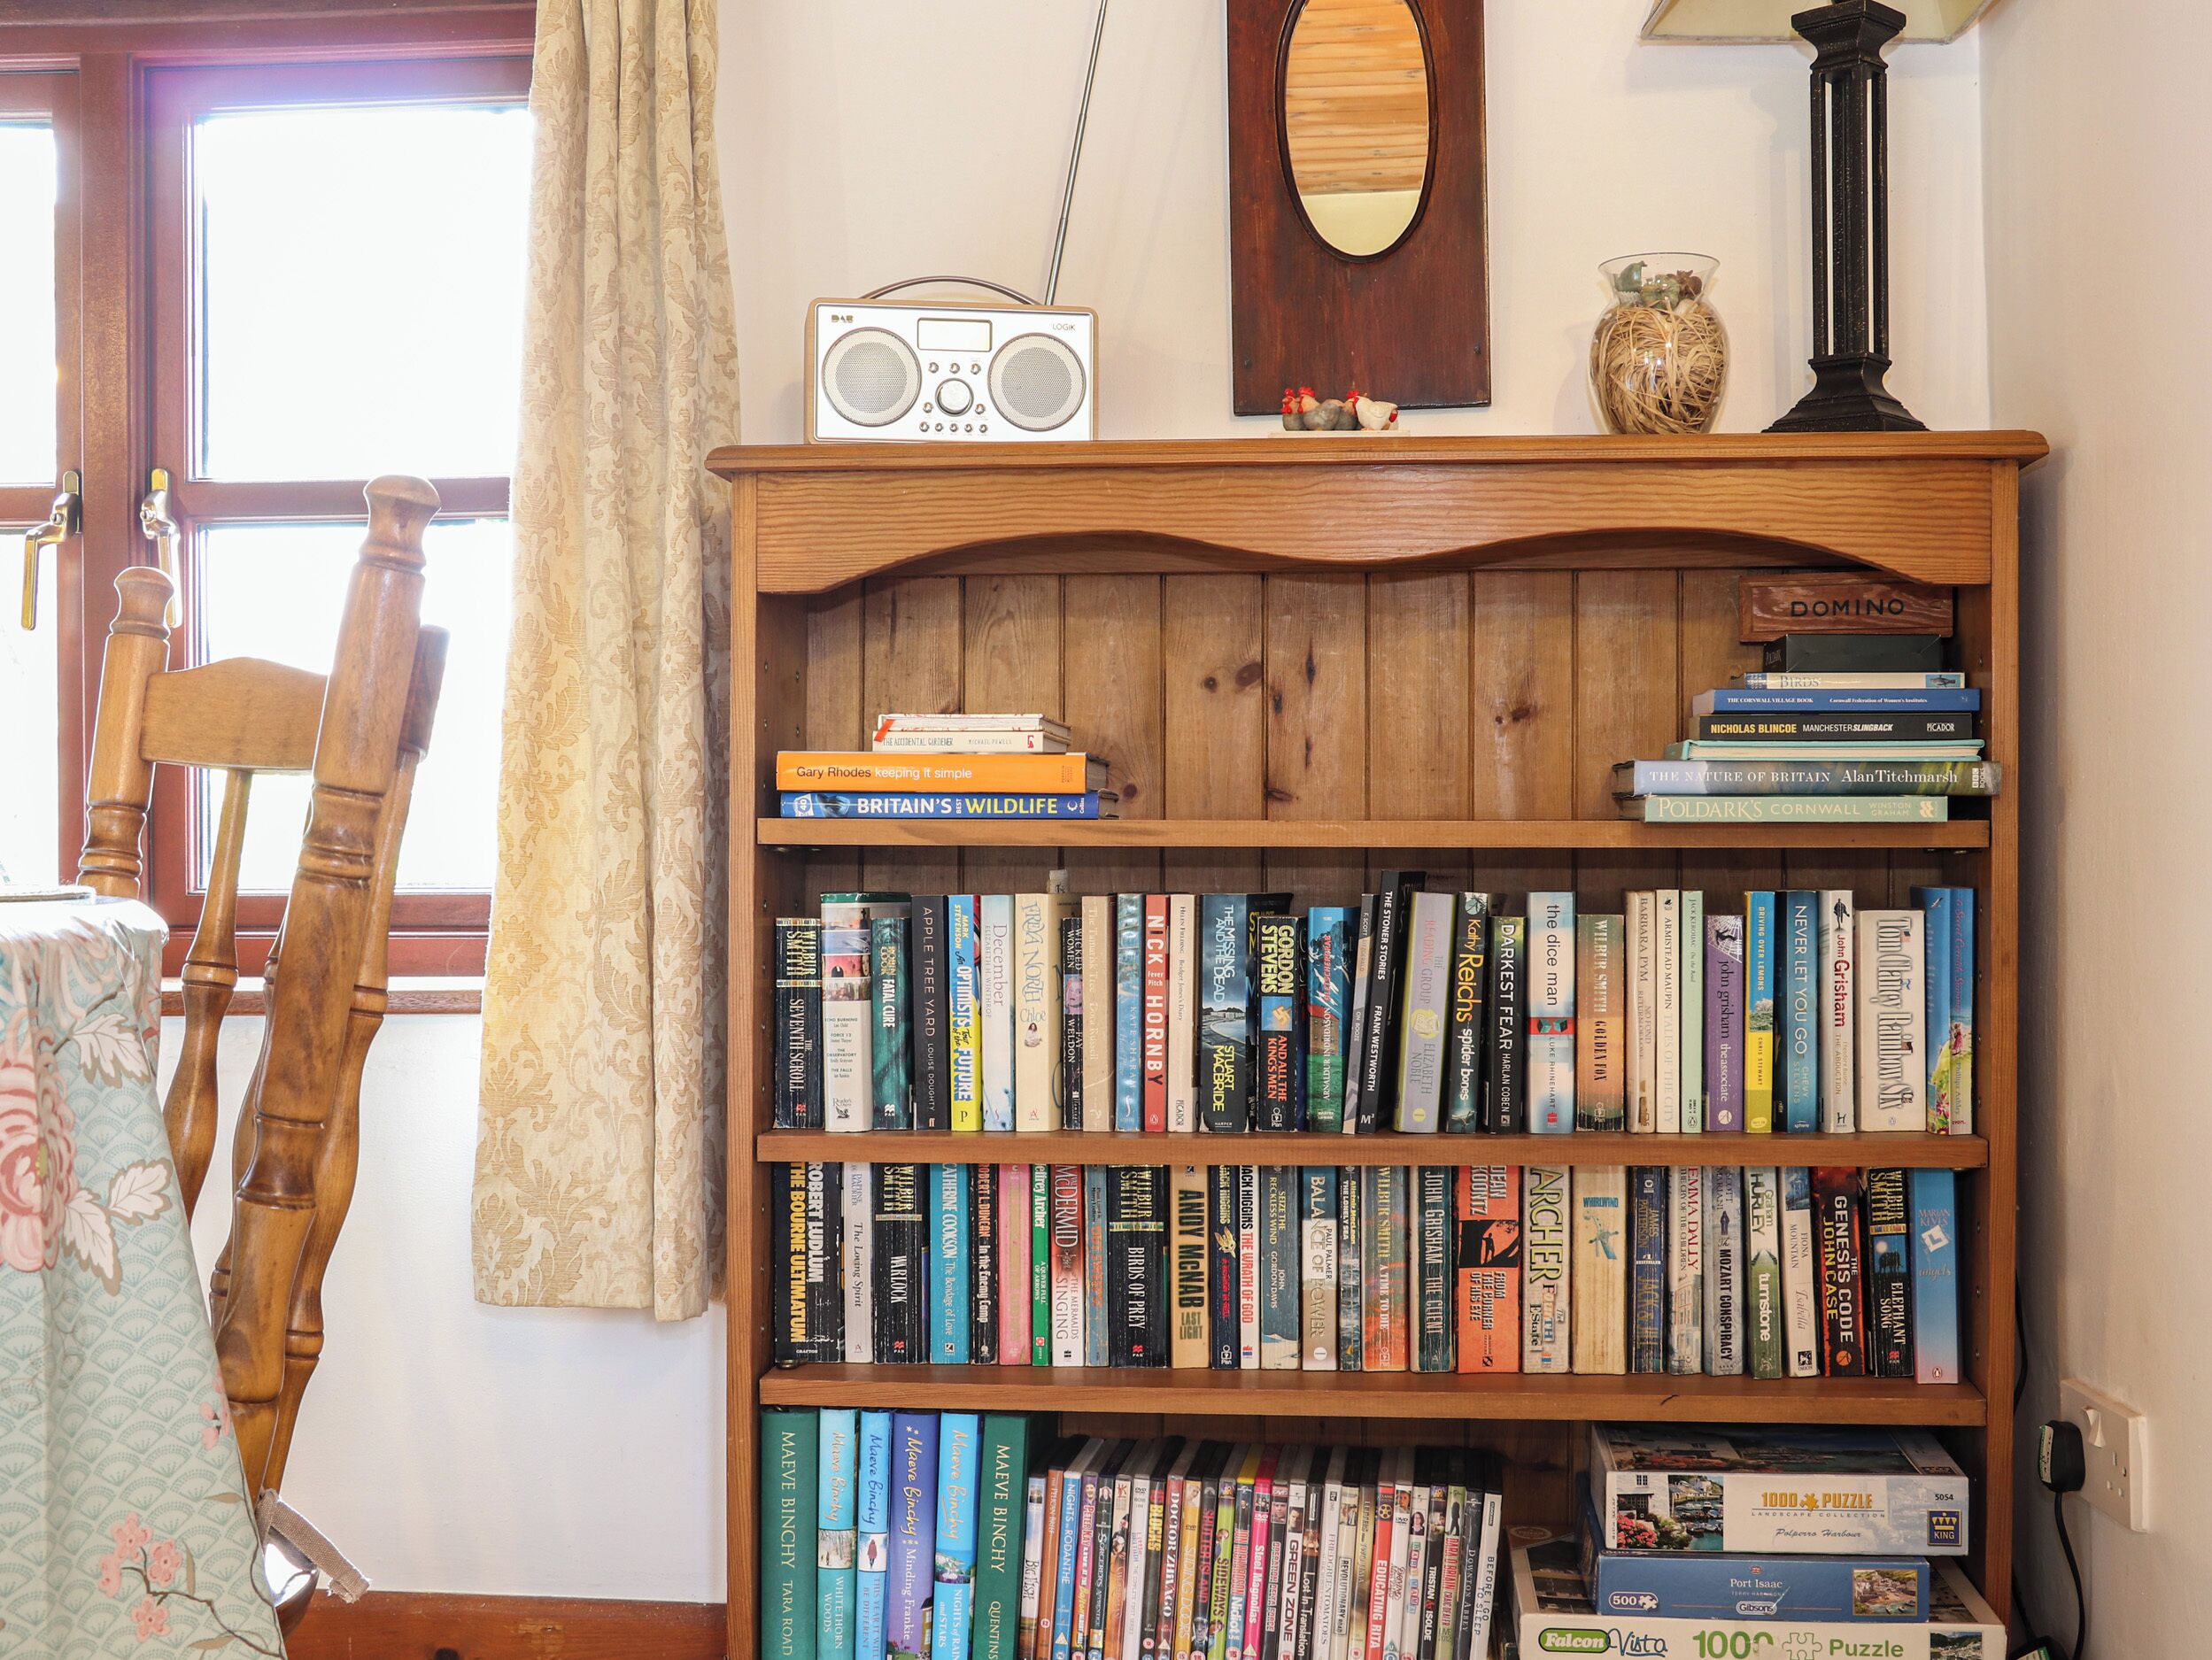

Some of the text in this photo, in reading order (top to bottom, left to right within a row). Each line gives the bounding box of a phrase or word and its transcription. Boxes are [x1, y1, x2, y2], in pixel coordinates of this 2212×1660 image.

[1790, 598, 1904, 616] DOMINO
[1780, 675, 1821, 689] BIRDS
[928, 737, 953, 746] GARDENER
[1711, 723, 1954, 733] NICHOLAS BLINCOE PICADOR
[797, 767, 971, 780] Gary Rhodes keeping it simple
[1650, 769, 1958, 783] THE NATURE OF BRITAIN Alan Titchmarsh
[858, 799, 952, 814] BRITAIN'S
[965, 799, 1057, 814] WILDLIFE
[1659, 799, 1860, 821] POLDARK'S CORNWALL
[924, 907, 933, 953] APPLE
[1148, 915, 1164, 964] NICK
[1381, 909, 1391, 943] STONER
[1468, 920, 1481, 951] Kathy
[1022, 902, 1044, 1002] FREYA NORTH
[1261, 926, 1278, 993] STEVENS
[1278, 925, 1294, 993] GORDON
[1379, 946, 1388, 980] STORIES
[1500, 925, 1515, 1001] DARKEST
[1546, 905, 1560, 1006] the dice man
[1870, 917, 1912, 1008] Tom Clancy
[924, 959, 934, 994] TREE
[1458, 954, 1483, 1022] Reichs
[1795, 906, 1807, 1054] NEVER LET YOU GO
[924, 1000, 935, 1037] YARD
[1147, 995, 1164, 1085] HORNBY
[1499, 1007, 1513, 1050] FEAR
[1224, 1045, 1234, 1090] STUART
[1367, 1006, 1382, 1091] FRANK WESTWORTH
[1461, 1029, 1473, 1100] spider bones
[1878, 1012, 1914, 1109] Rainbow Six
[1213, 1045, 1224, 1111] MACBRIDE
[1179, 1190, 1204, 1238] ANDY
[1530, 1169, 1564, 1283] ARCHER
[1583, 1197, 1618, 1208] WHIRLWIND
[790, 1193, 806, 1342] BOURNE ULTIMATUM
[854, 1246, 863, 1278] Loving
[1241, 1191, 1253, 1323] HIGGINS THE WRATH OF GOD
[1425, 1172, 1443, 1333] JOHN GRISHAM THE CLIENT
[1823, 1216, 1837, 1319] JOHN CASE
[1835, 1196, 1852, 1342] GENESIS CODE
[854, 1281, 863, 1306] Spirit
[891, 1255, 907, 1303] WARLOCK
[1129, 1247, 1145, 1328] BIRDS OF PREY
[1181, 1312, 1201, 1324] LAST
[1721, 1250, 1732, 1360] MOZART CONSPIRACY
[1179, 1325, 1203, 1340] LIGHT
[901, 1436, 923, 1539] Maeve Binchy
[992, 1445, 1009, 1572] MAEVE BINCHY
[1762, 1492, 1872, 1509] 1000 PUZZLE
[781, 1432, 795, 1656] MAEVE BINCHY TARA ROAD
[1776, 1528, 1860, 1538] Polperro Harbour
[901, 1548, 917, 1640] Minding Frankie
[1249, 1545, 1265, 1624] Steel Magnolias
[1284, 1540, 1298, 1641] GREEN ZONE
[1304, 1571, 1315, 1594] Lost
[1370, 1560, 1387, 1648] EDUCATING RITA
[1613, 1595, 1636, 1605] 500
[1755, 1579, 1783, 1588] Isaac
[988, 1602, 1001, 1659] QUENTINS
[1739, 1603, 1773, 1612] Gibsons
[1298, 1608, 1312, 1656] Translation
[1544, 1633, 1604, 1648] Falcon
[1829, 1639, 1904, 1657] Puzzle
